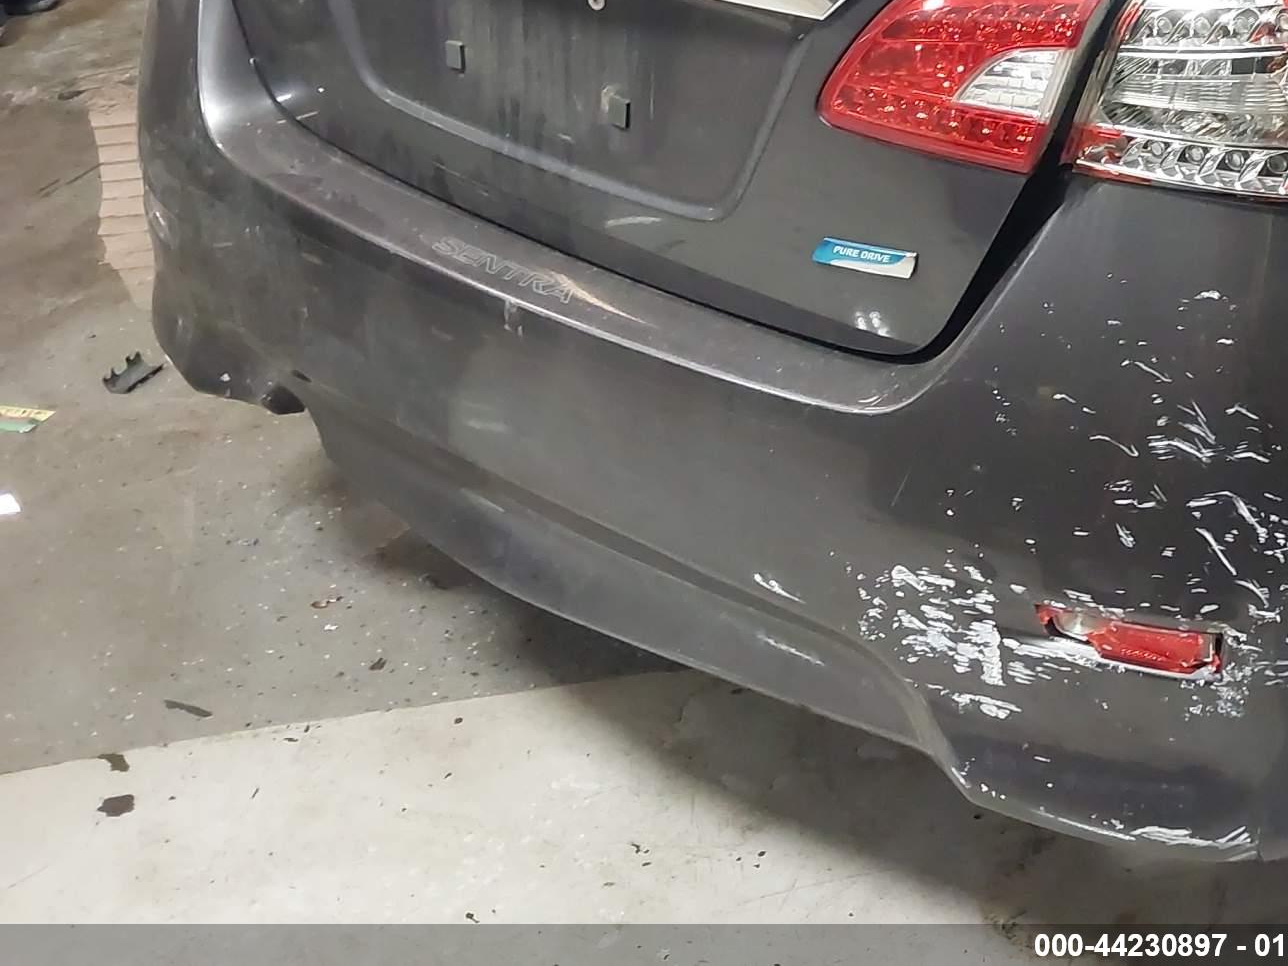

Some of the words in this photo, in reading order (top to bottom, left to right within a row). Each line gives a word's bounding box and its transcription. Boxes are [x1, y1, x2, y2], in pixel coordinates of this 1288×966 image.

[431, 235, 573, 304] SENTRA
[832, 245, 860, 258] PURE
[860, 251, 891, 263] DRIVE
